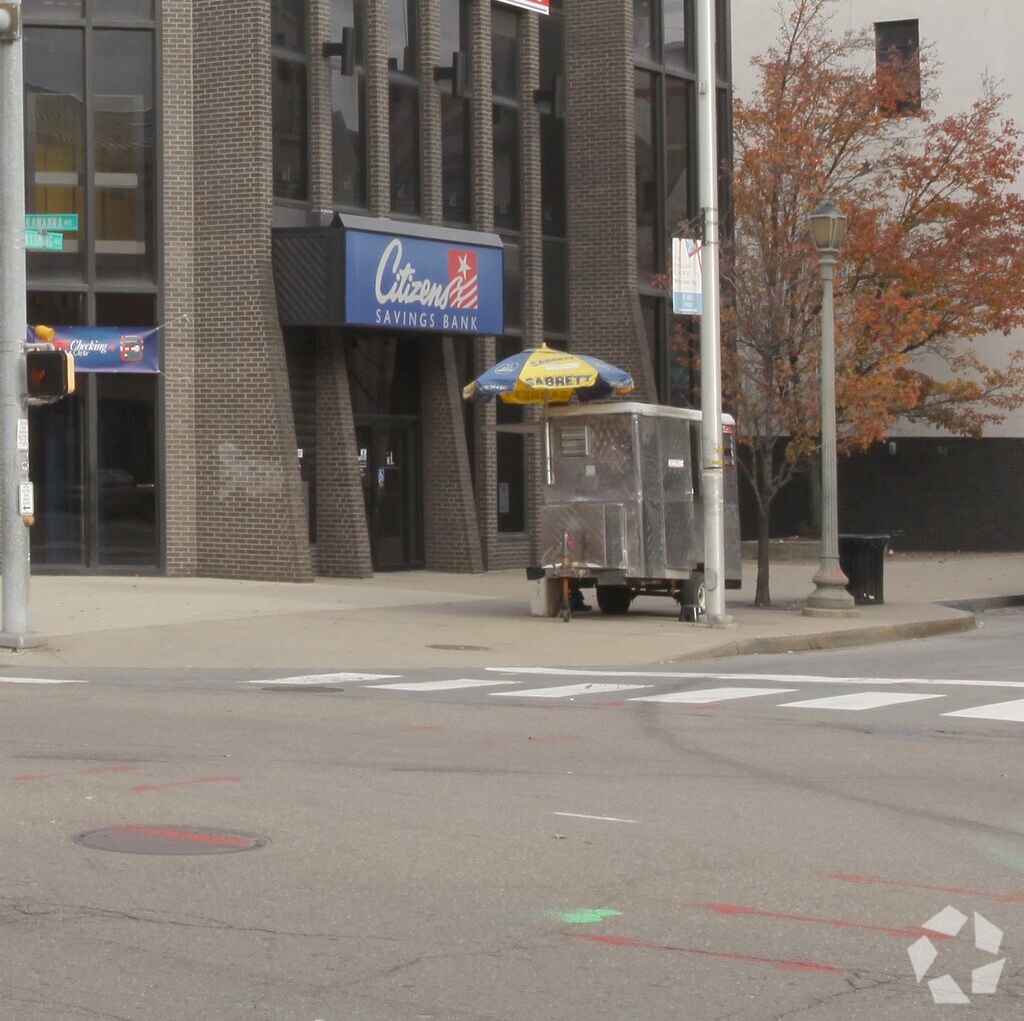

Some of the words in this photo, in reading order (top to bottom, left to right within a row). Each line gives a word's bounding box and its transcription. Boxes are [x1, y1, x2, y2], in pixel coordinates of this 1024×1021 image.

[26, 216, 63, 229] KAWANNA
[375, 238, 462, 310] Citizens
[375, 308, 435, 328] SAVINGS
[443, 314, 478, 331] BANK
[69, 339, 108, 355] Checking
